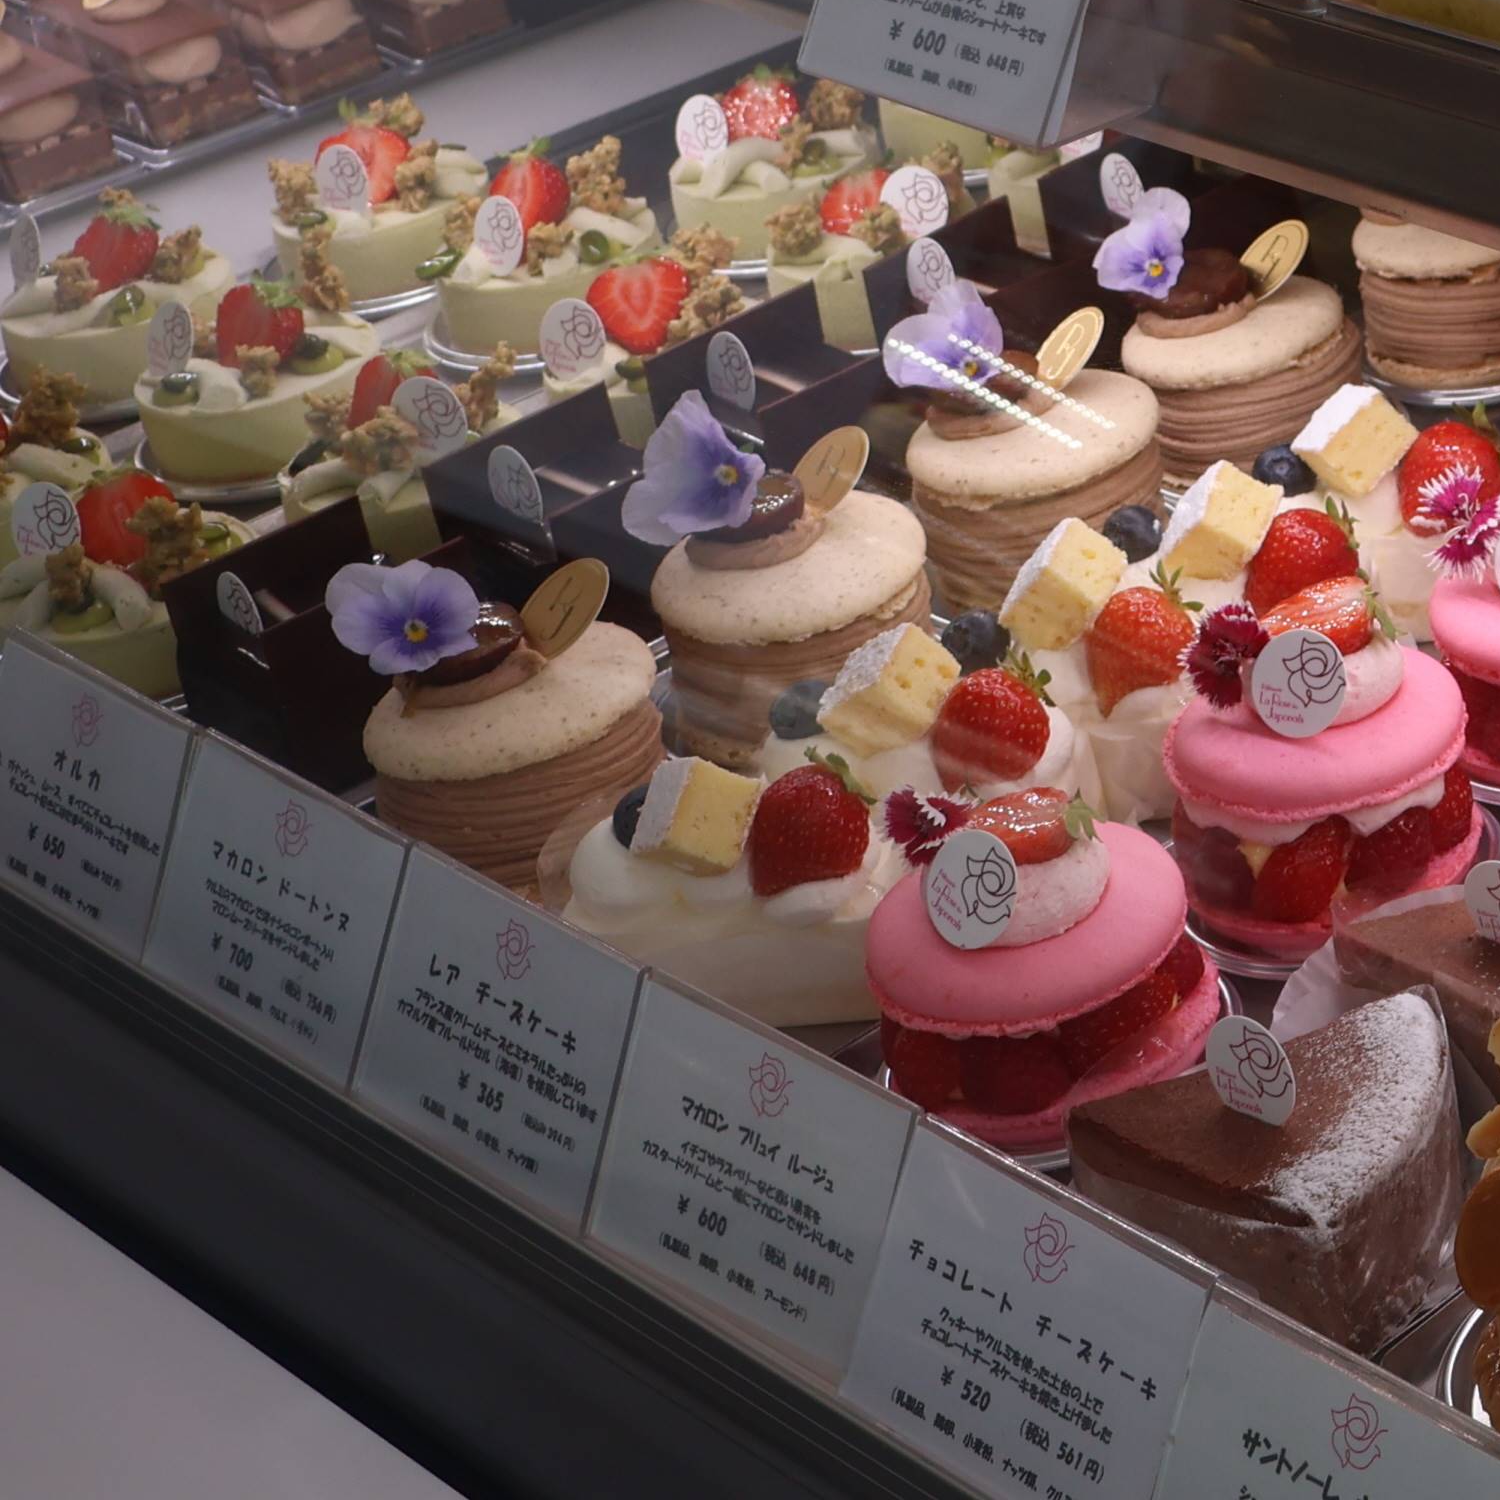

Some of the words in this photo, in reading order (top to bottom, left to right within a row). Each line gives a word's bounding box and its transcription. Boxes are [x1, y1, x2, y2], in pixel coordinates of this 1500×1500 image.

[888, 19, 904, 41] ¥
[913, 28, 947, 56] 600
[54, 748, 102, 794] オルカ
[42, 831, 66, 860] 650
[212, 840, 269, 886] マカロン
[279, 877, 350, 932] ドートンヌ
[230, 942, 255, 972] 700
[429, 954, 460, 986] レア
[458, 1070, 471, 1091] ¥
[476, 1081, 504, 1114] 365
[682, 1095, 729, 1133] マカロン
[739, 1125, 782, 1164] フリュイ
[788, 1155, 835, 1194] ルージュ
[677, 1193, 691, 1216] ¥
[698, 1207, 728, 1238] 600
[793, 1262, 835, 1297] 648円)
[909, 1238, 1014, 1315] チョコレート
[940, 1365, 955, 1388] ¥
[960, 1379, 991, 1414] 520
[1056, 1441, 1105, 1486] 561円)
